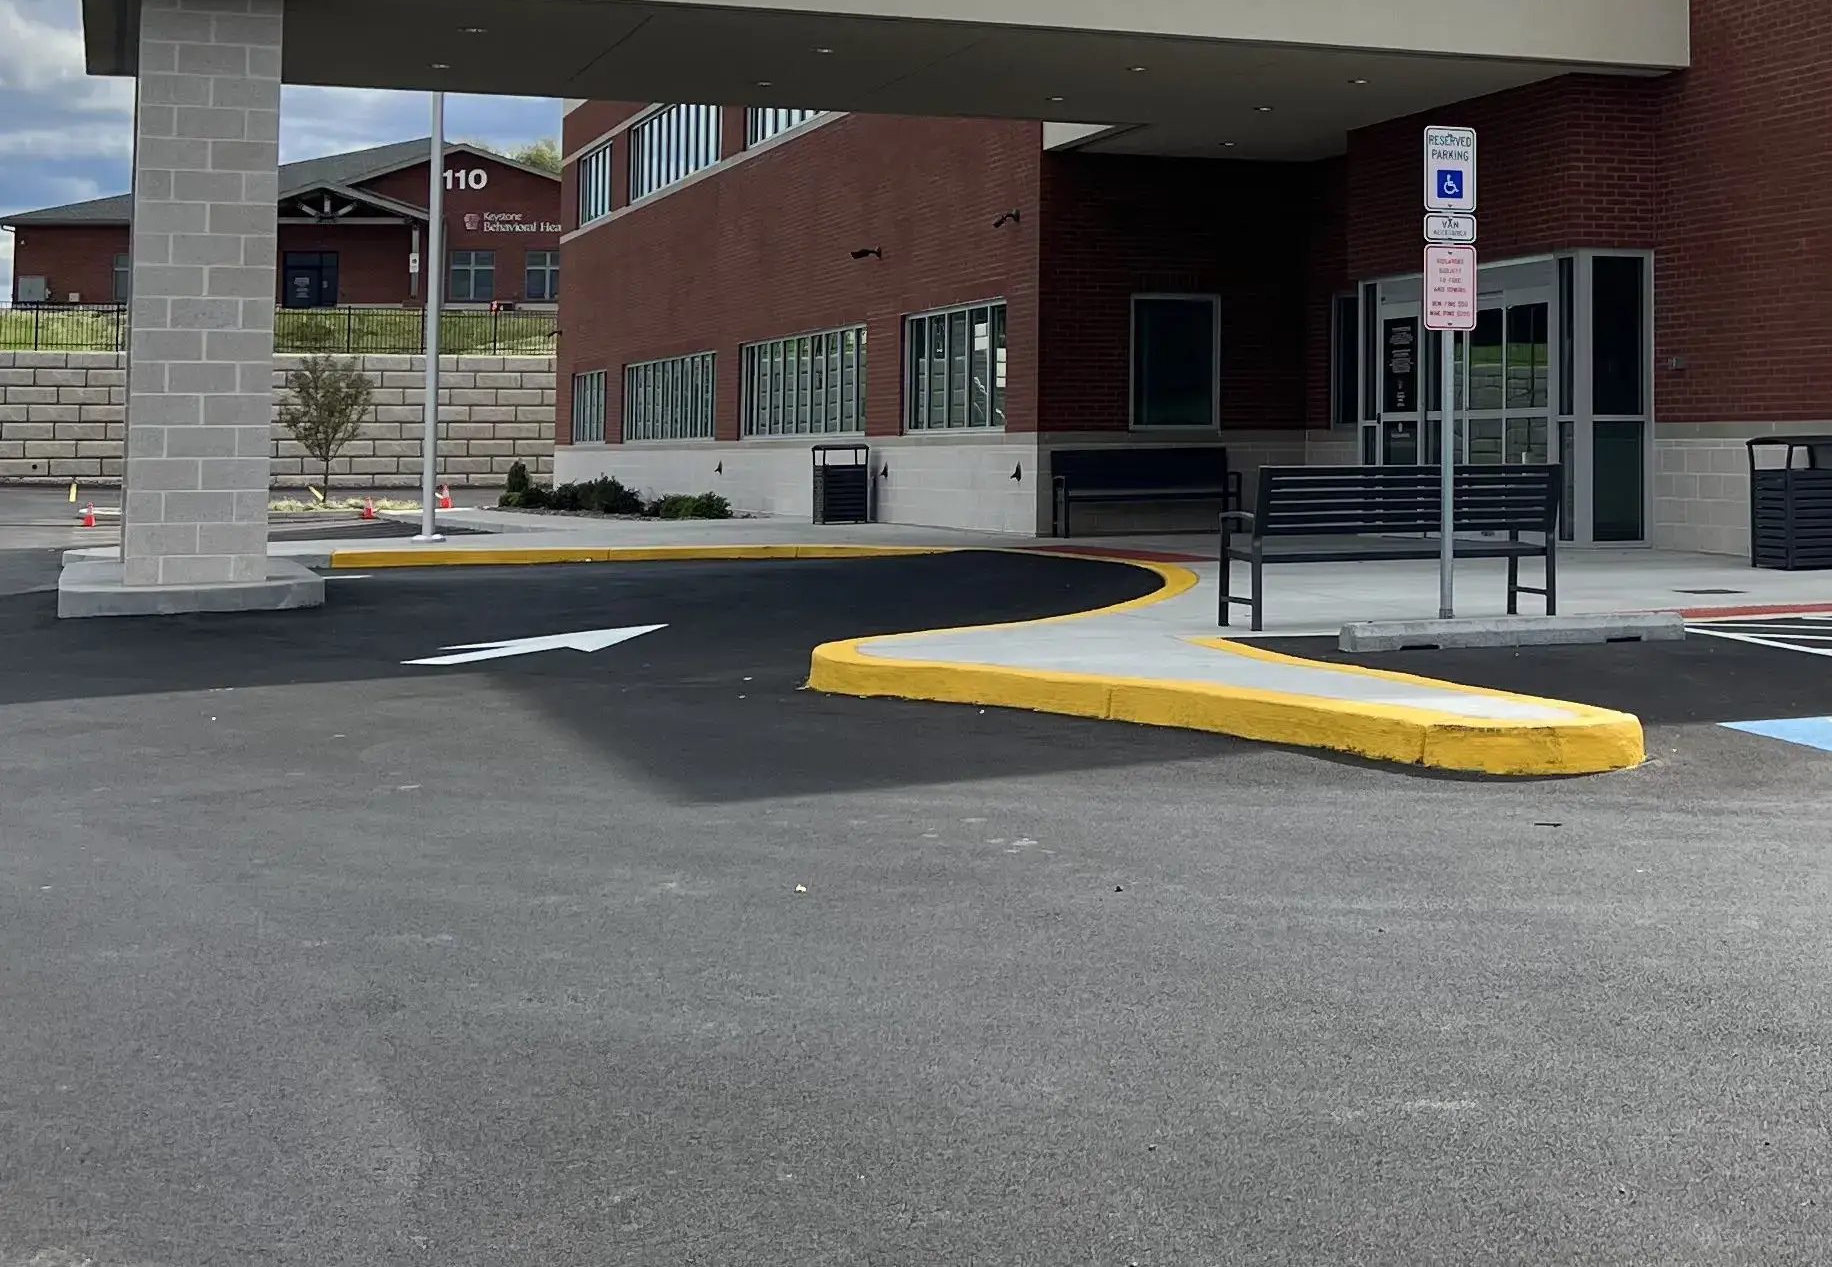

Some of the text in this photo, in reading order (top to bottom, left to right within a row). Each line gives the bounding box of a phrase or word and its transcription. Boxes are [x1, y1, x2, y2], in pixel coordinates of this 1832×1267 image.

[1428, 134, 1472, 147] RESERVED
[1431, 149, 1469, 162] PARKING
[442, 168, 488, 190] 110
[483, 212, 523, 222] Keystone
[483, 222, 537, 232] Behavioral
[1441, 220, 1460, 230] VAN
